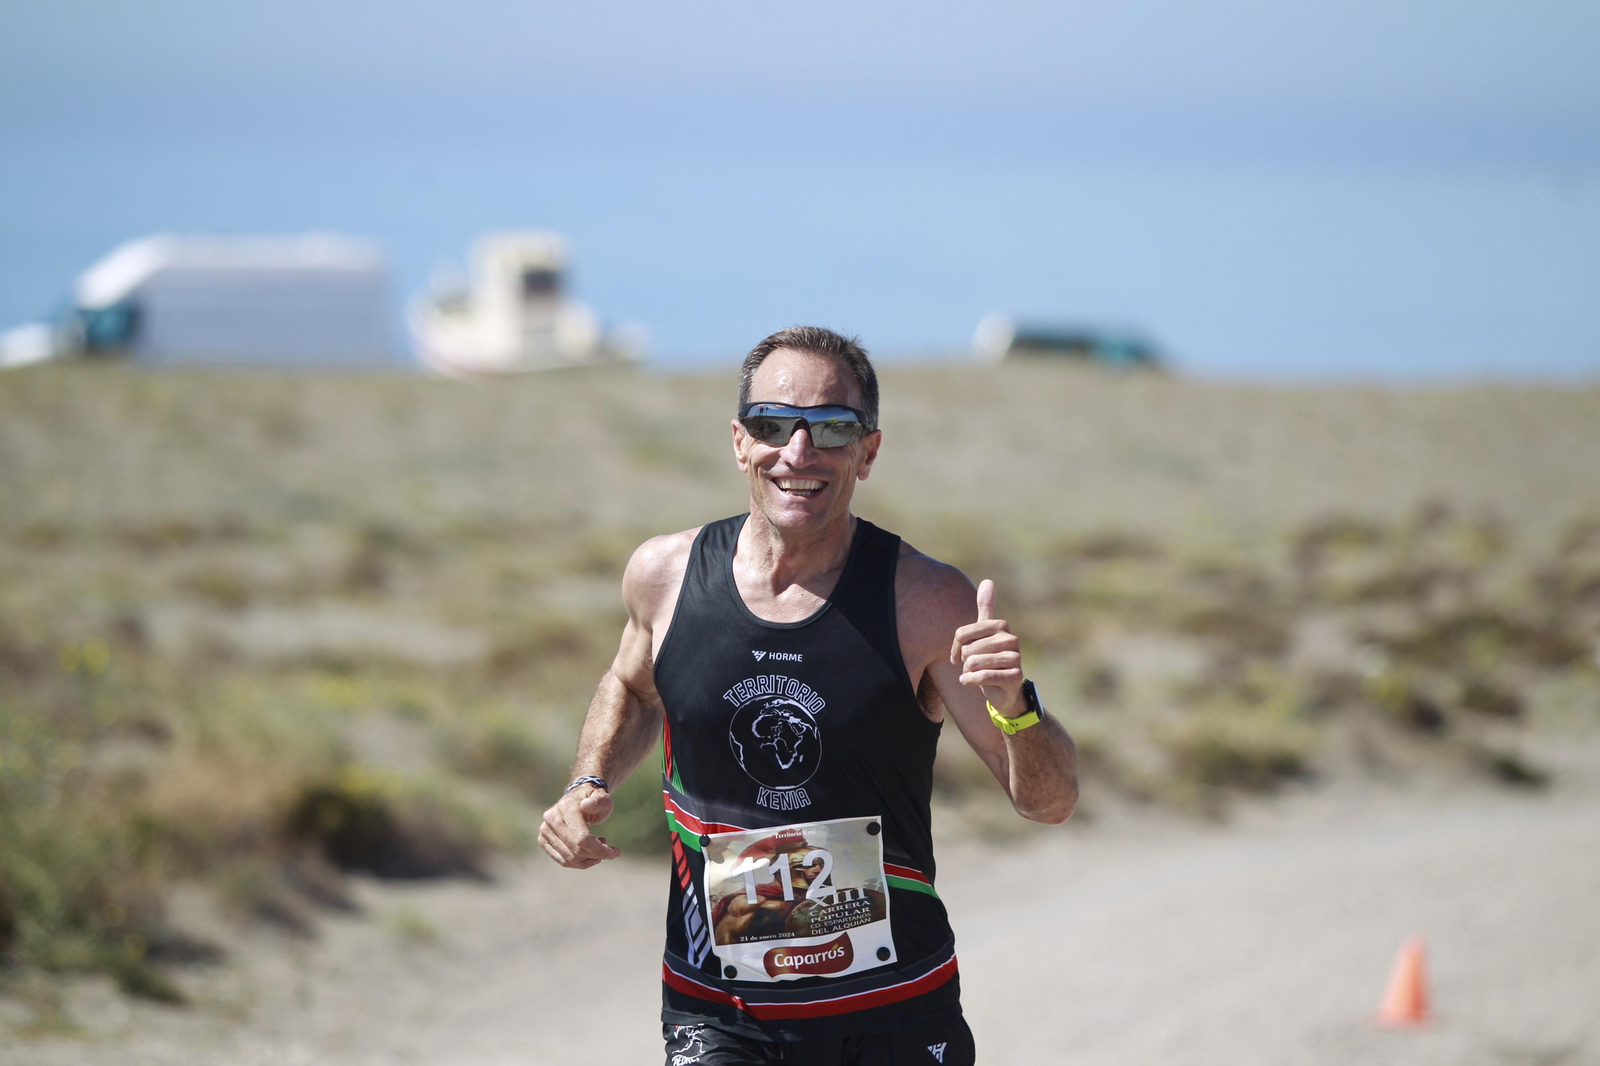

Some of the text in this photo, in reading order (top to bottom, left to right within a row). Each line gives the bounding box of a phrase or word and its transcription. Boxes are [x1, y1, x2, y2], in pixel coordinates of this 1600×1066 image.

[768, 652, 803, 662] HORME
[723, 675, 825, 714] TERRITORIO
[756, 787, 811, 810] KENIA
[732, 850, 836, 904] 112
[809, 900, 871, 917] CARRERA
[810, 907, 870, 924] POPULAR
[824, 913, 871, 926] ESPARTANOS
[777, 931, 796, 939] 2024
[811, 927, 830, 936] DEL
